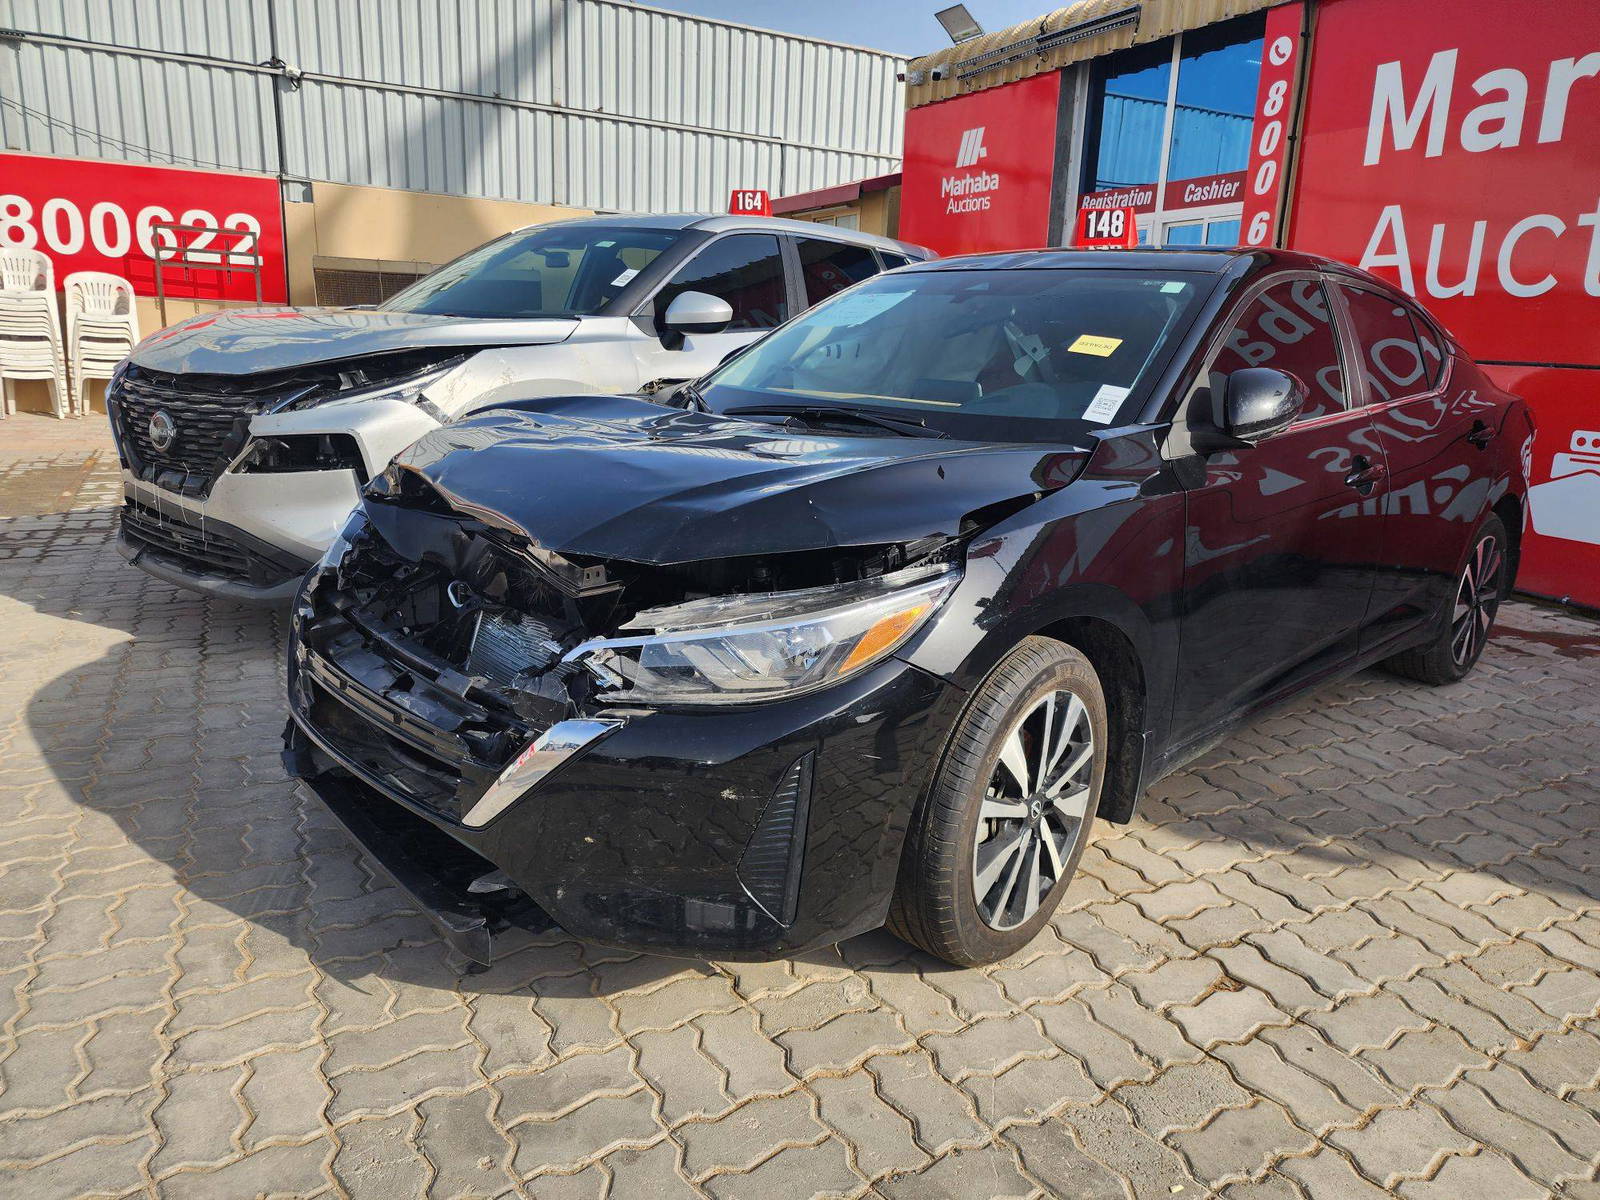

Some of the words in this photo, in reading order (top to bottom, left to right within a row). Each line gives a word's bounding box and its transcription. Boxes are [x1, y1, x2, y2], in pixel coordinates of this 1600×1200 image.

[1364, 48, 1600, 167] Mar
[942, 170, 999, 198] Marhaba
[1184, 179, 1240, 203] Cashier
[737, 191, 762, 211] 164
[946, 195, 990, 214] Auctions
[0, 194, 263, 266] 800622
[1088, 209, 1125, 238] 148
